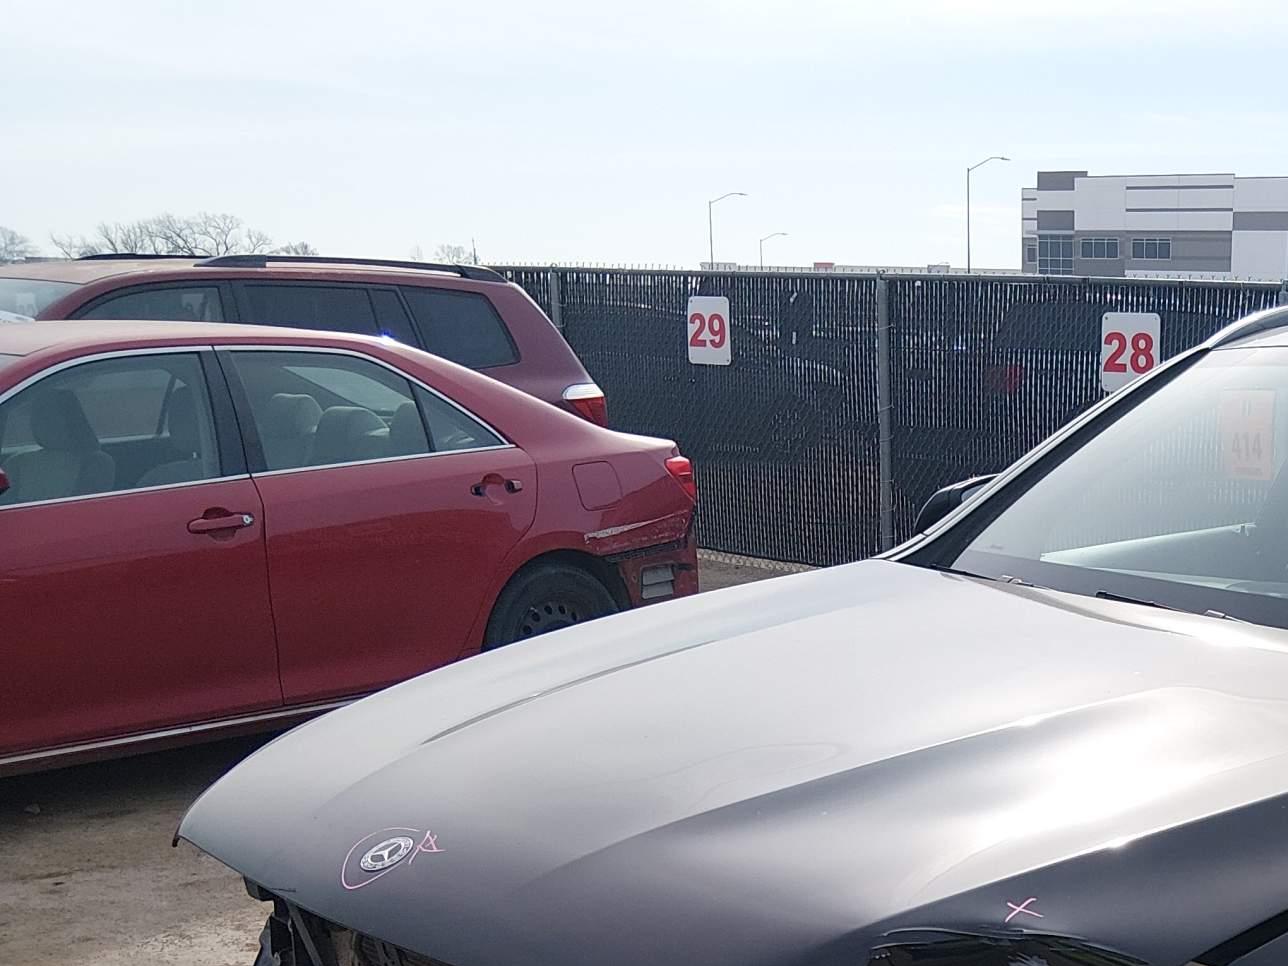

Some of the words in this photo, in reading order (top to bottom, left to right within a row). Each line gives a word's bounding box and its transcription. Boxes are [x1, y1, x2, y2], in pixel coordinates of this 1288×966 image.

[690, 313, 727, 349] 29
[1103, 332, 1155, 374] 28
[1232, 432, 1263, 462] 414
